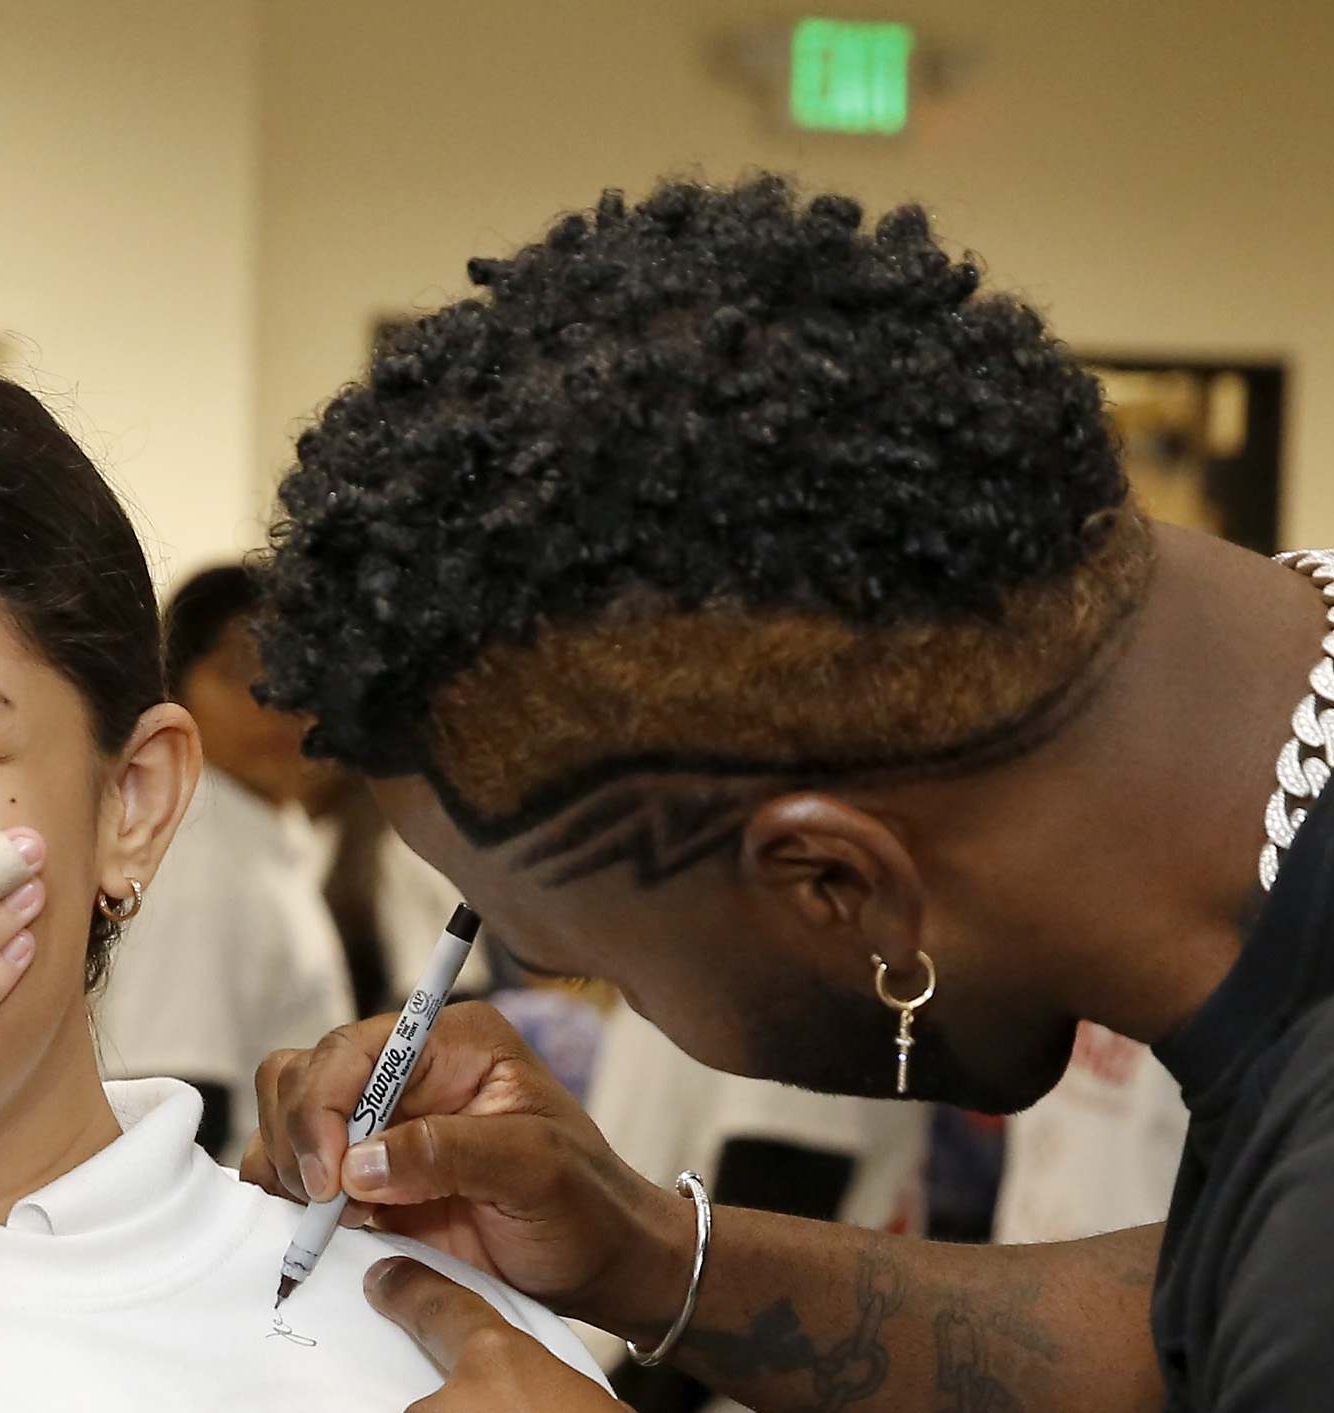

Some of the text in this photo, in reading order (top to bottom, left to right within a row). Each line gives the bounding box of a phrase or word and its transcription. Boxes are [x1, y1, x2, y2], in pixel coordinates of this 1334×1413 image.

[400, 1024, 411, 1038] FINE
[406, 1022, 419, 1041] POINT
[378, 1050, 417, 1123] Permanent Marker
